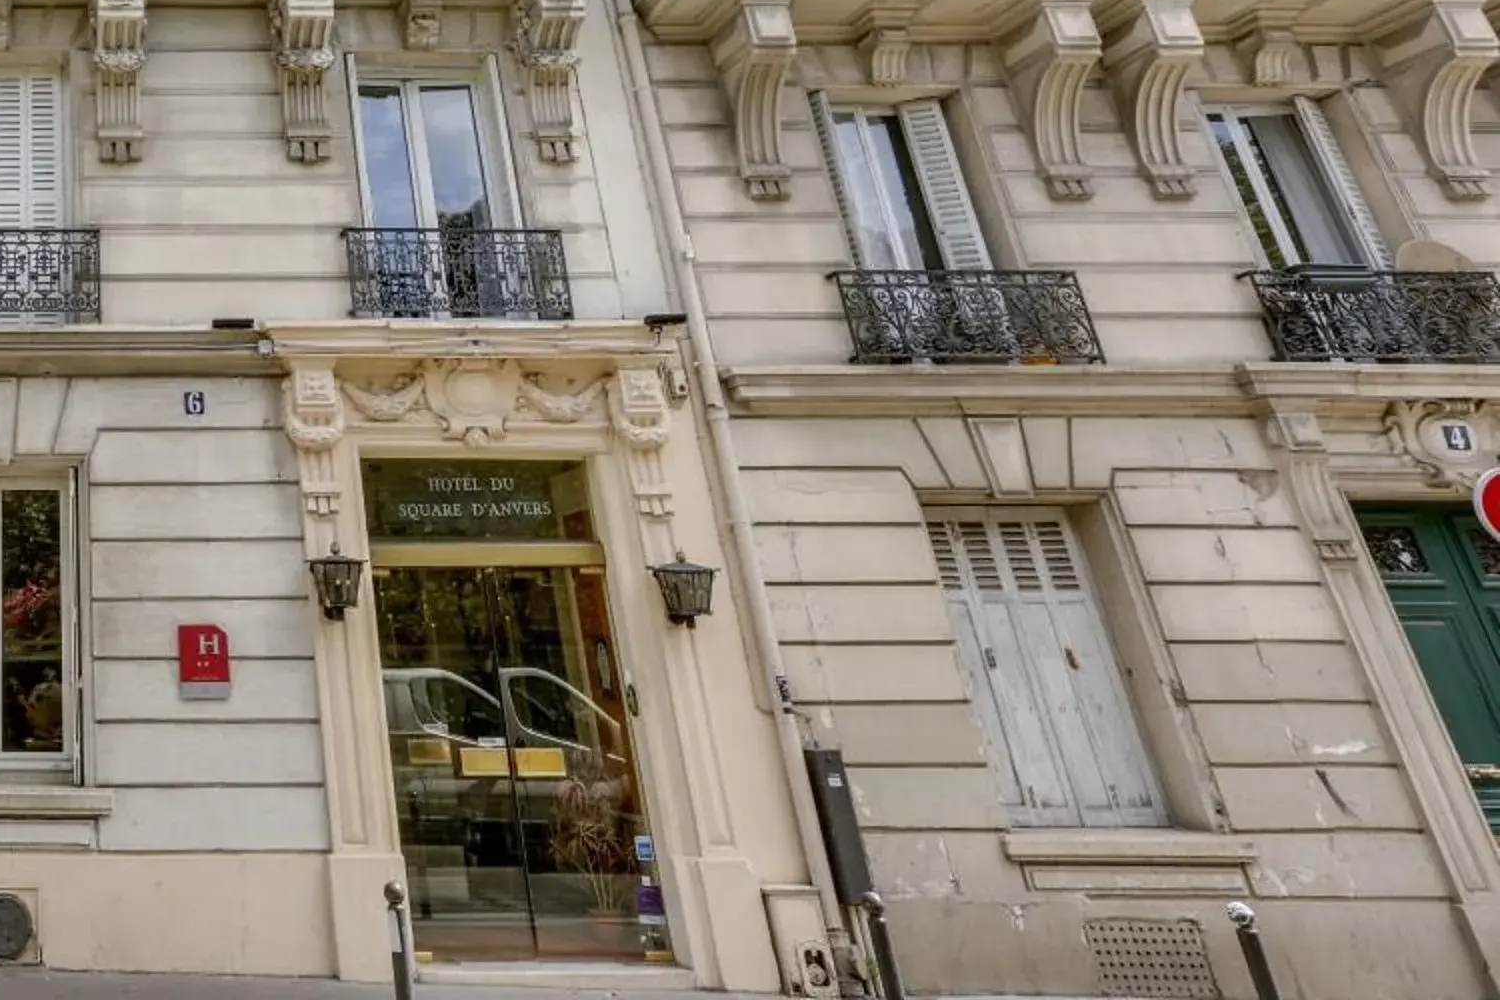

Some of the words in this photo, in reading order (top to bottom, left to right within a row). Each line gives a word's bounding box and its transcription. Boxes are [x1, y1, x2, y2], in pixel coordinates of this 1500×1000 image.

[187, 391, 202, 413] 6
[1451, 426, 1466, 449] 4
[428, 477, 483, 492] HOTEL
[490, 477, 515, 491] DU
[399, 503, 463, 520] SQUARE
[472, 501, 552, 517] D'ANVERS
[198, 633, 220, 655] H
